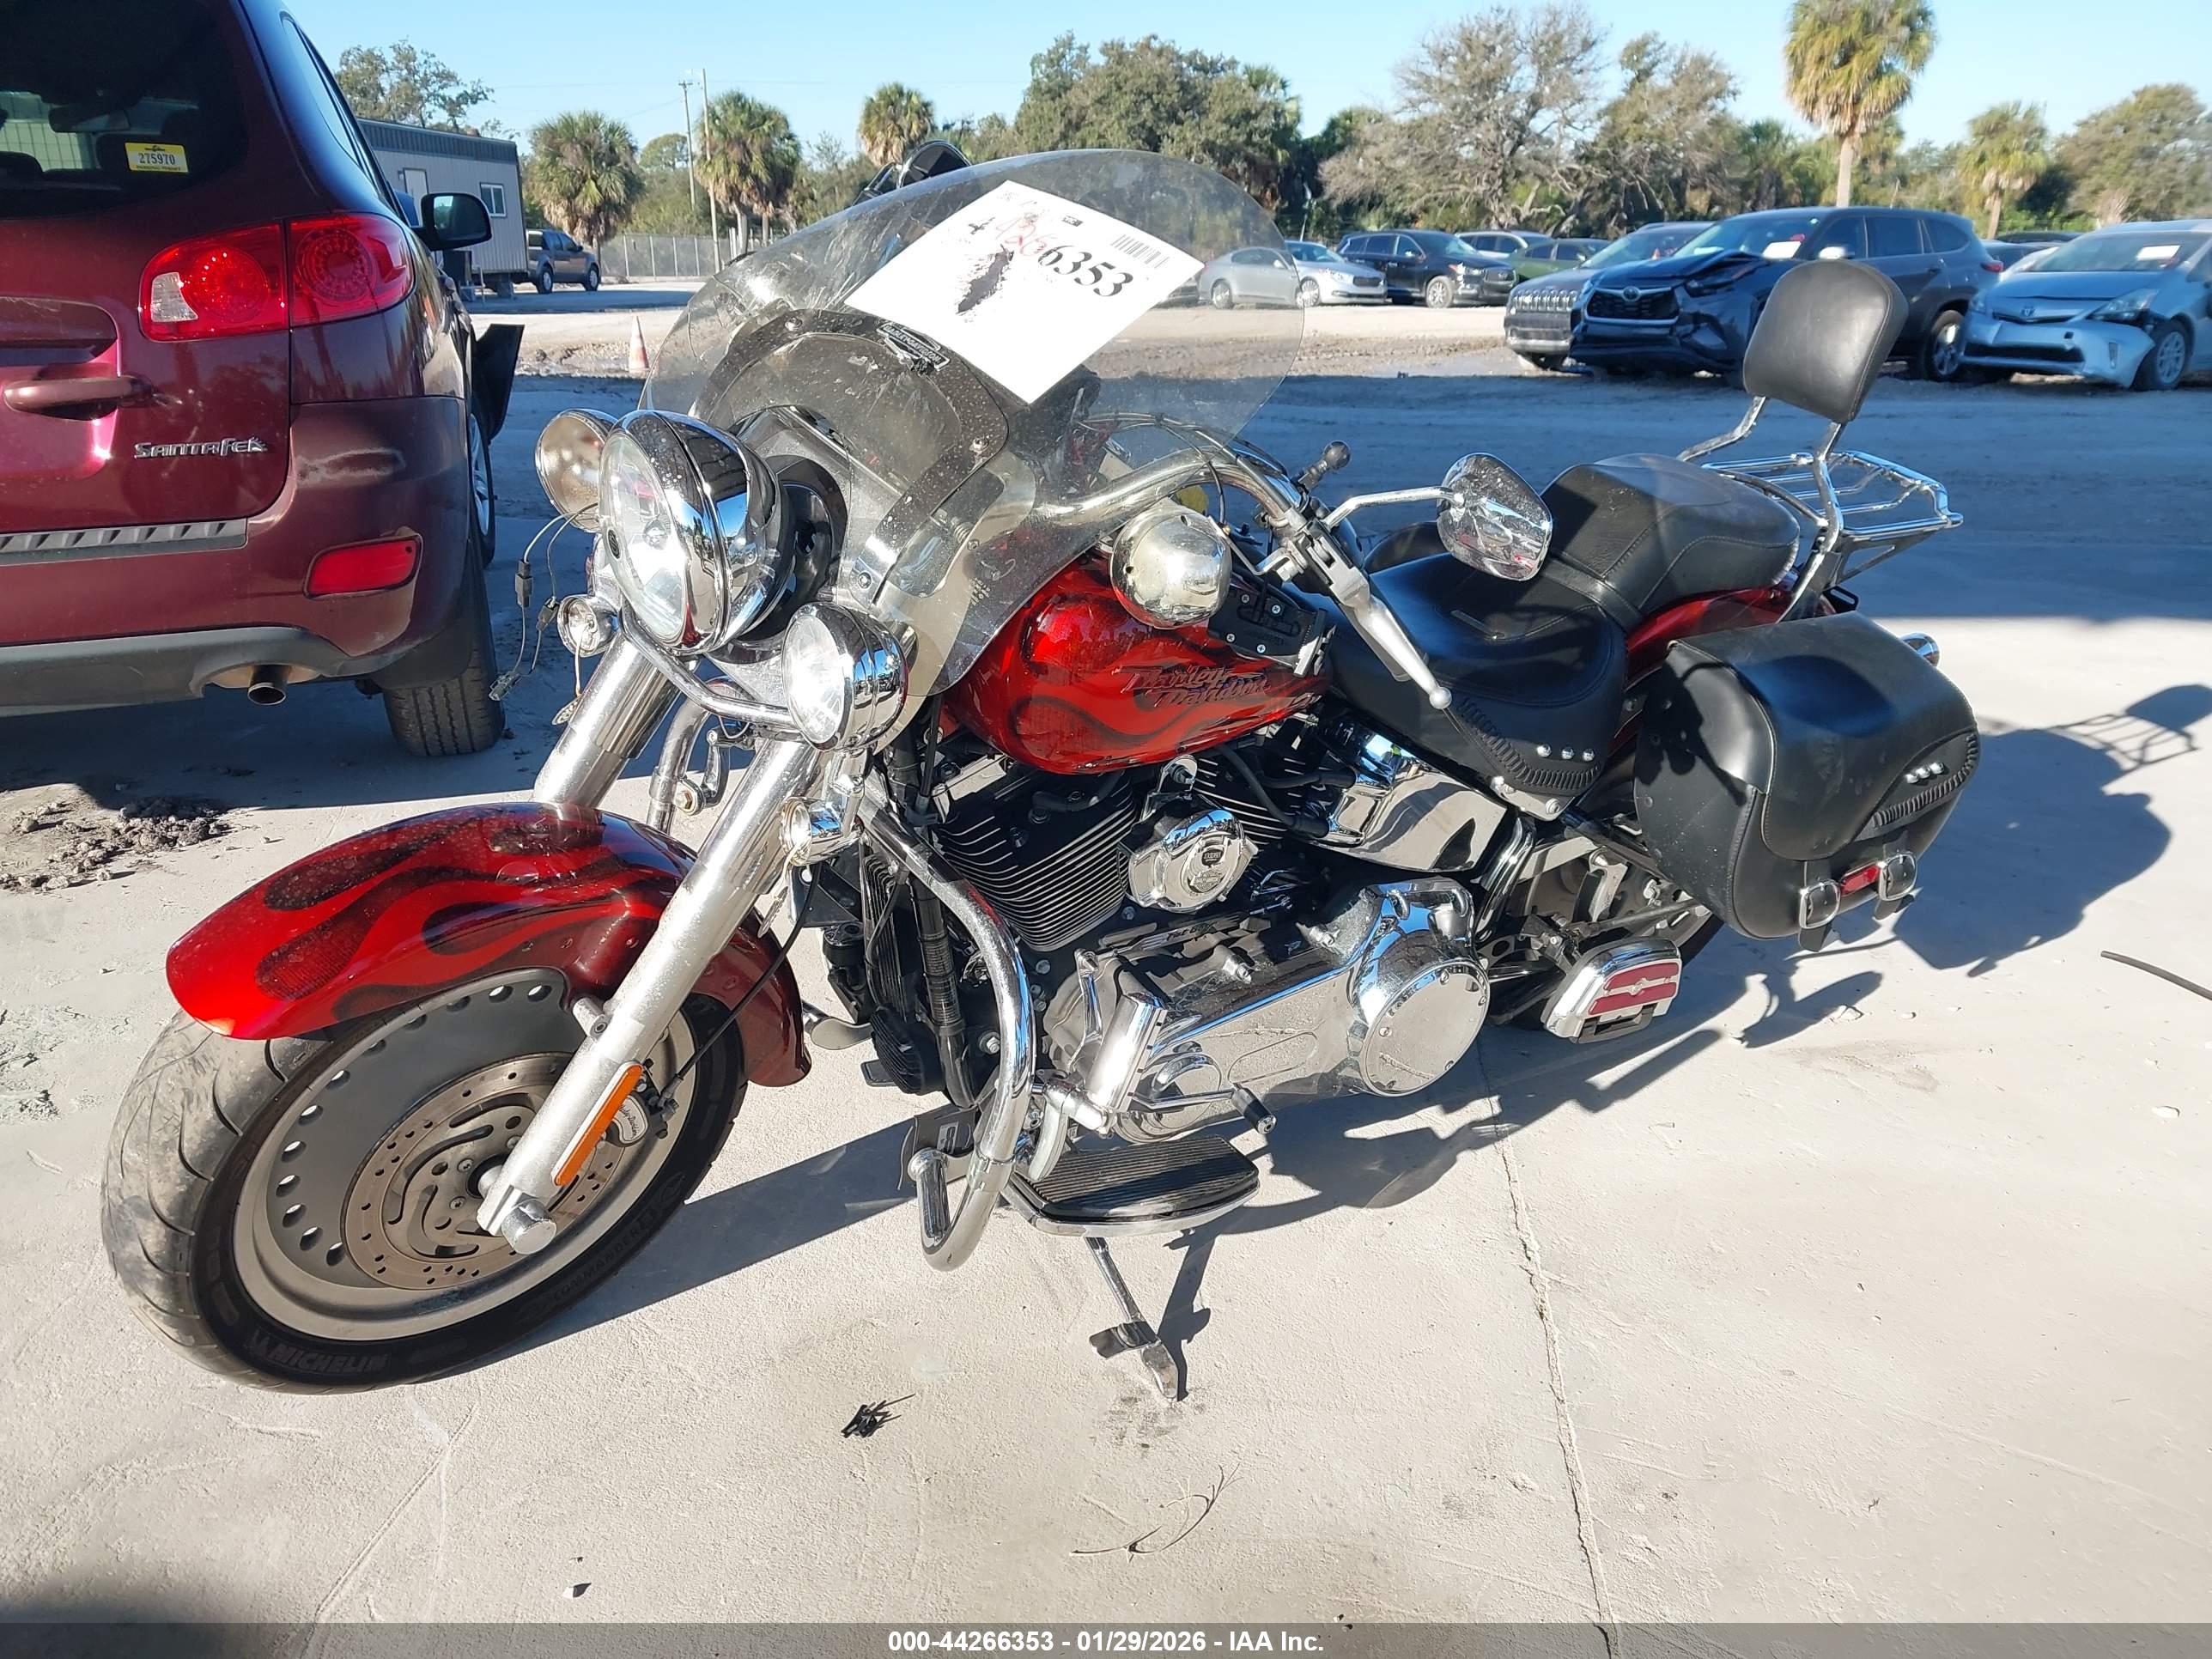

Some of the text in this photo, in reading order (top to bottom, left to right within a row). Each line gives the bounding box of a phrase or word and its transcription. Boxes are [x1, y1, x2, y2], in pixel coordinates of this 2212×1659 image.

[137, 152, 176, 165] 275970
[1037, 245, 1133, 297] 6353
[268, 1342, 390, 1374] MICHELIN
